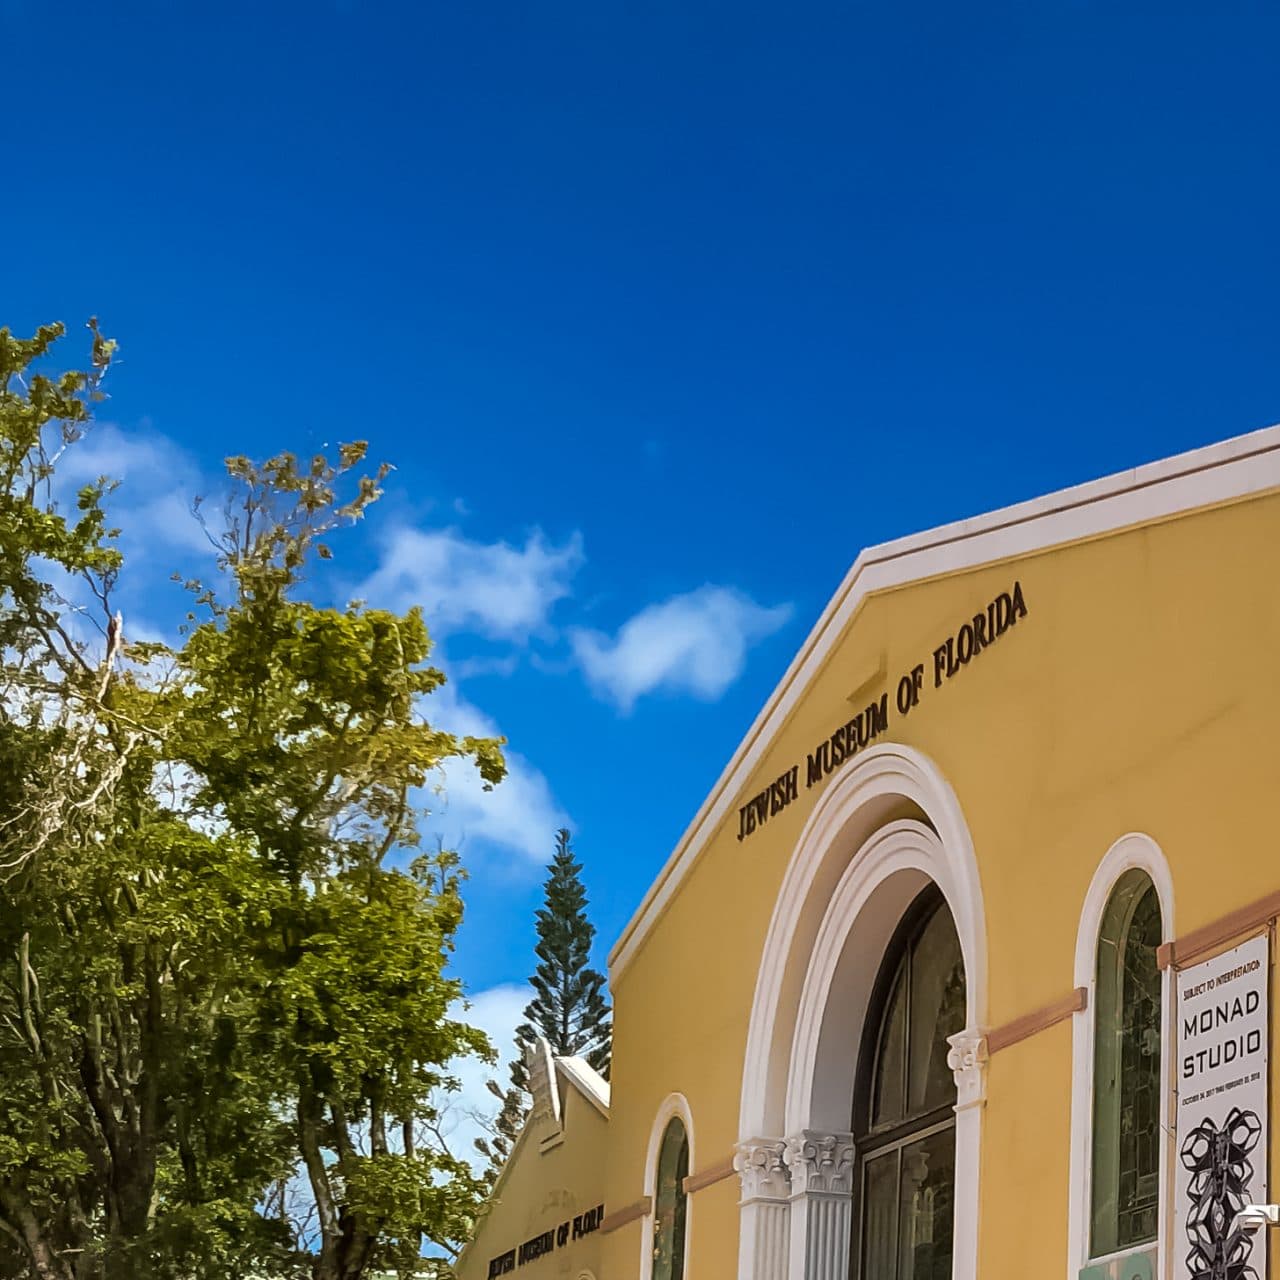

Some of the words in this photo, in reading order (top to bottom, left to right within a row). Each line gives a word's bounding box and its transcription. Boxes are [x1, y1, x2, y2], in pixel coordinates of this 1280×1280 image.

[737, 765, 799, 842] JEWISH
[806, 692, 889, 788] MUSEUM
[897, 663, 925, 715] OF
[933, 581, 1029, 689] FLORIDA
[1183, 981, 1206, 1001] SUBJECT
[1207, 979, 1215, 991] TO
[1216, 959, 1261, 987] INTERPRETATION
[1184, 990, 1260, 1041] MONAD
[1183, 1029, 1260, 1079] STUDIO
[557, 1221, 570, 1248] OF
